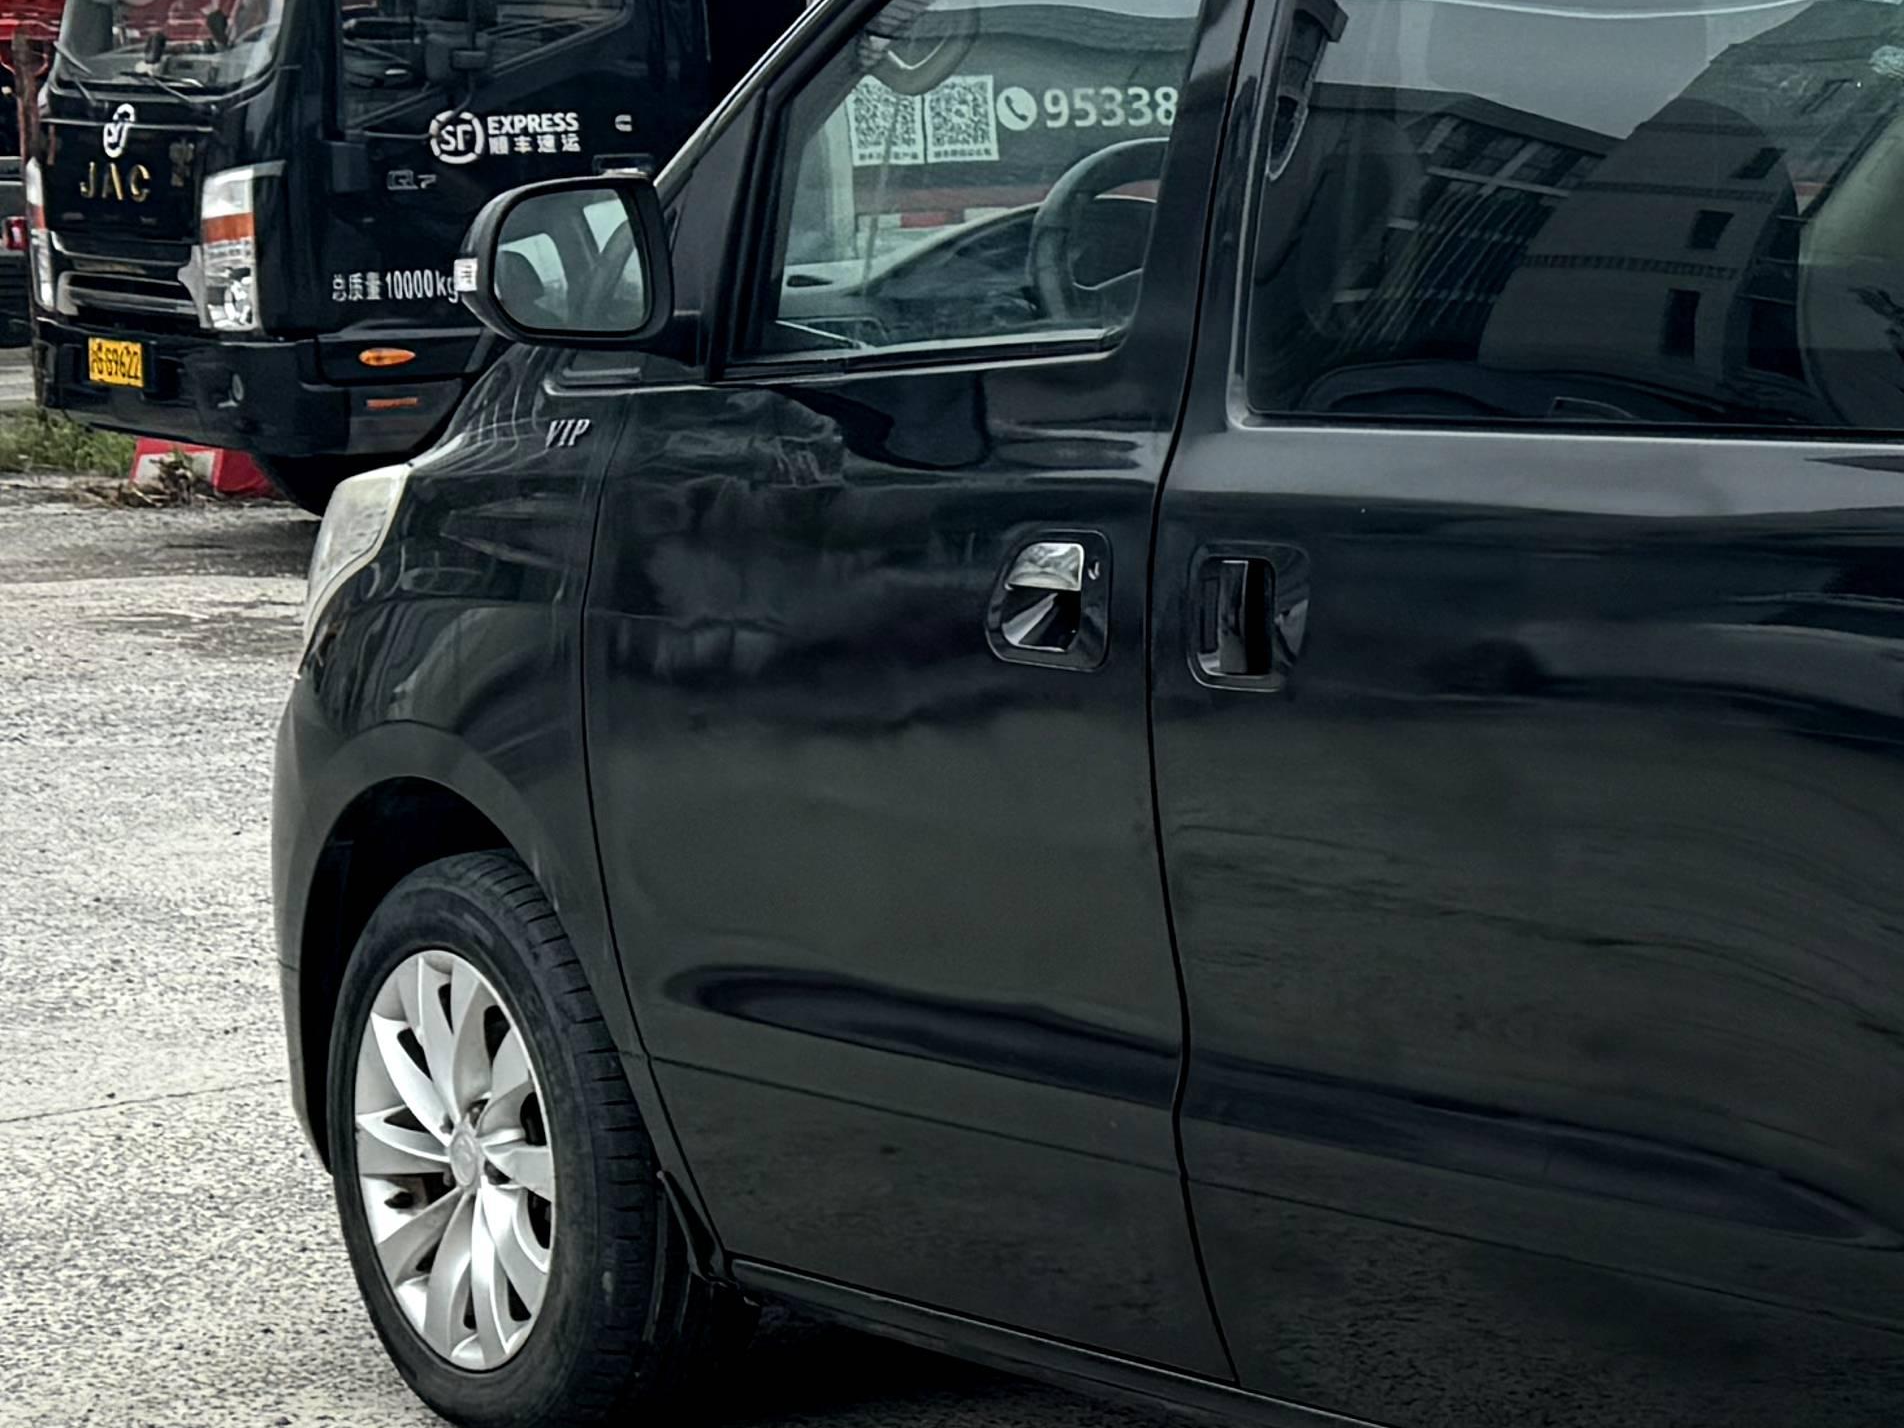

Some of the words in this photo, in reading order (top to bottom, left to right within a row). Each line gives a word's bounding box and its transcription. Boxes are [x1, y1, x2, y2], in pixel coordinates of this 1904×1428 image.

[487, 113, 580, 135] EXPRESS
[1043, 86, 1178, 128] 95338
[80, 161, 150, 202] JAC
[545, 418, 590, 447] VIP
